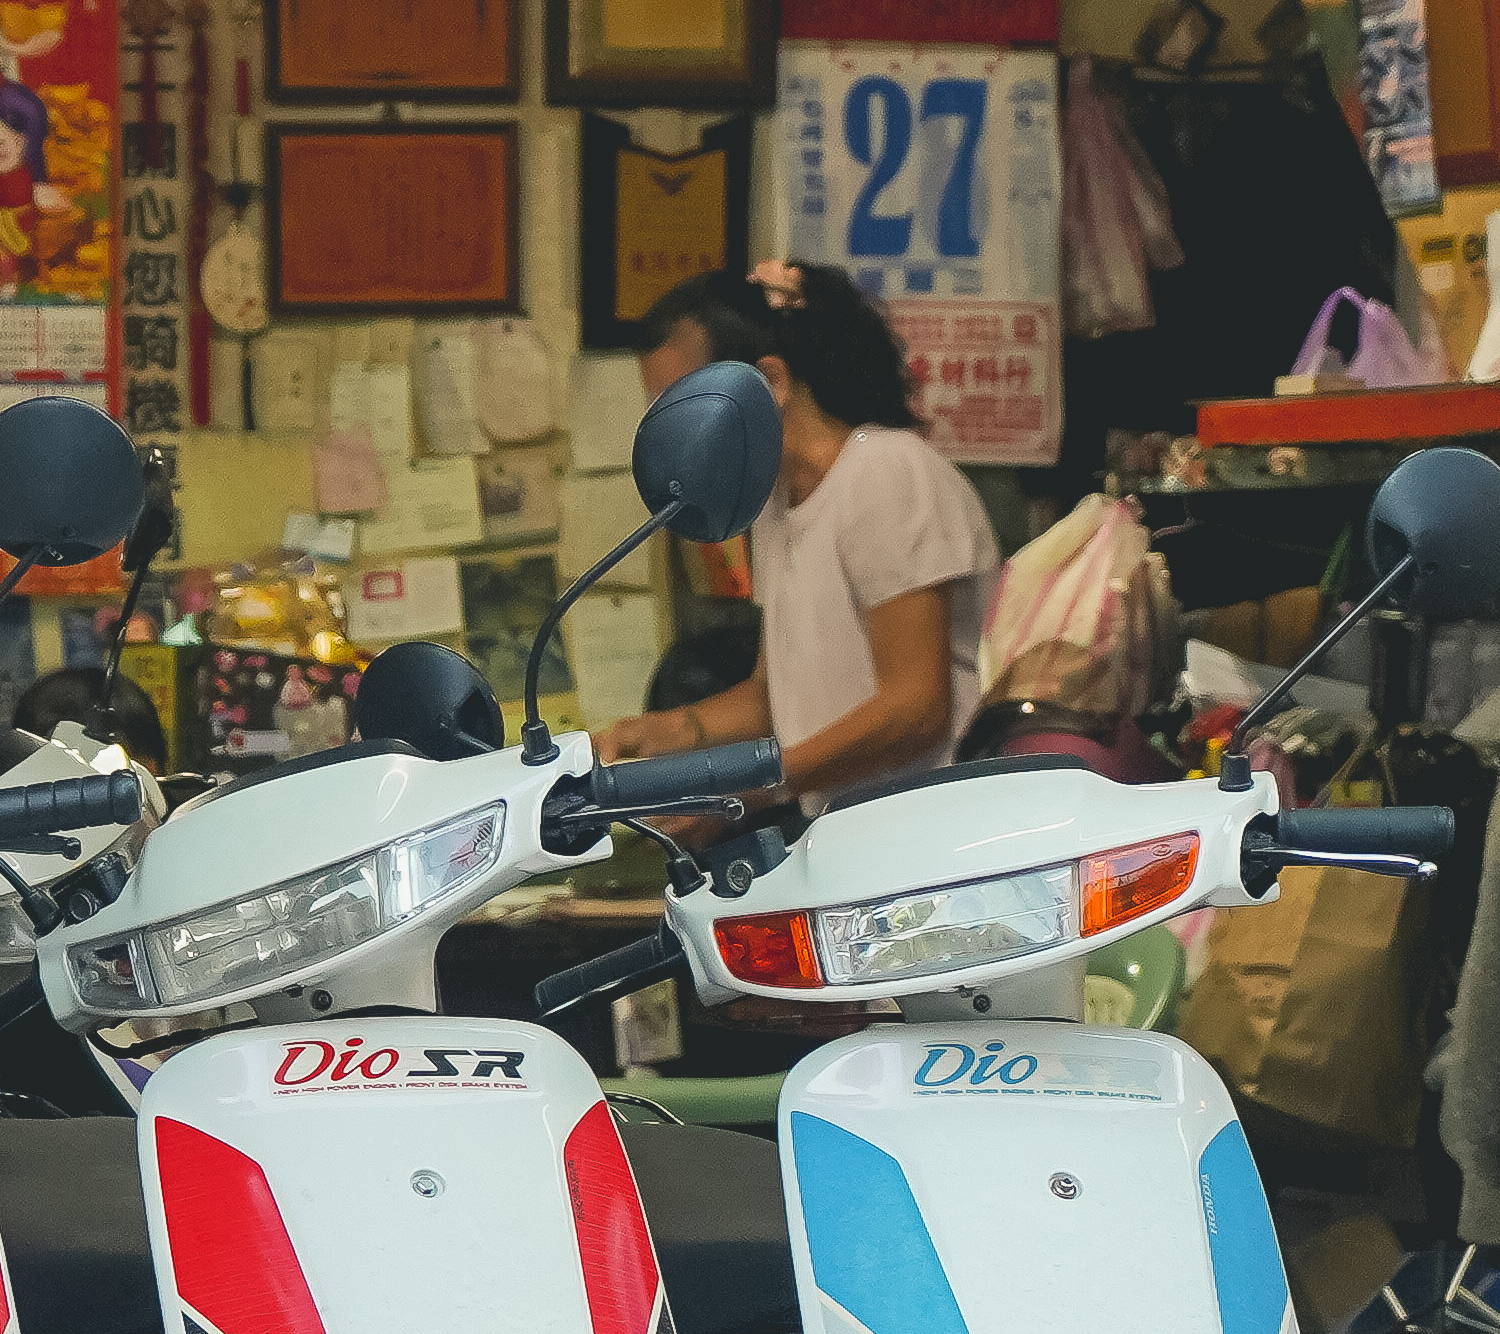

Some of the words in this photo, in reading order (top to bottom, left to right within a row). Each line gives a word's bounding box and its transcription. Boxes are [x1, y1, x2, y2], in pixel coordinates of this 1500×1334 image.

[842, 75, 987, 258] 27
[274, 1037, 400, 1085] Dio
[406, 1049, 526, 1078] SR
[914, 1042, 1038, 1087] Dio
